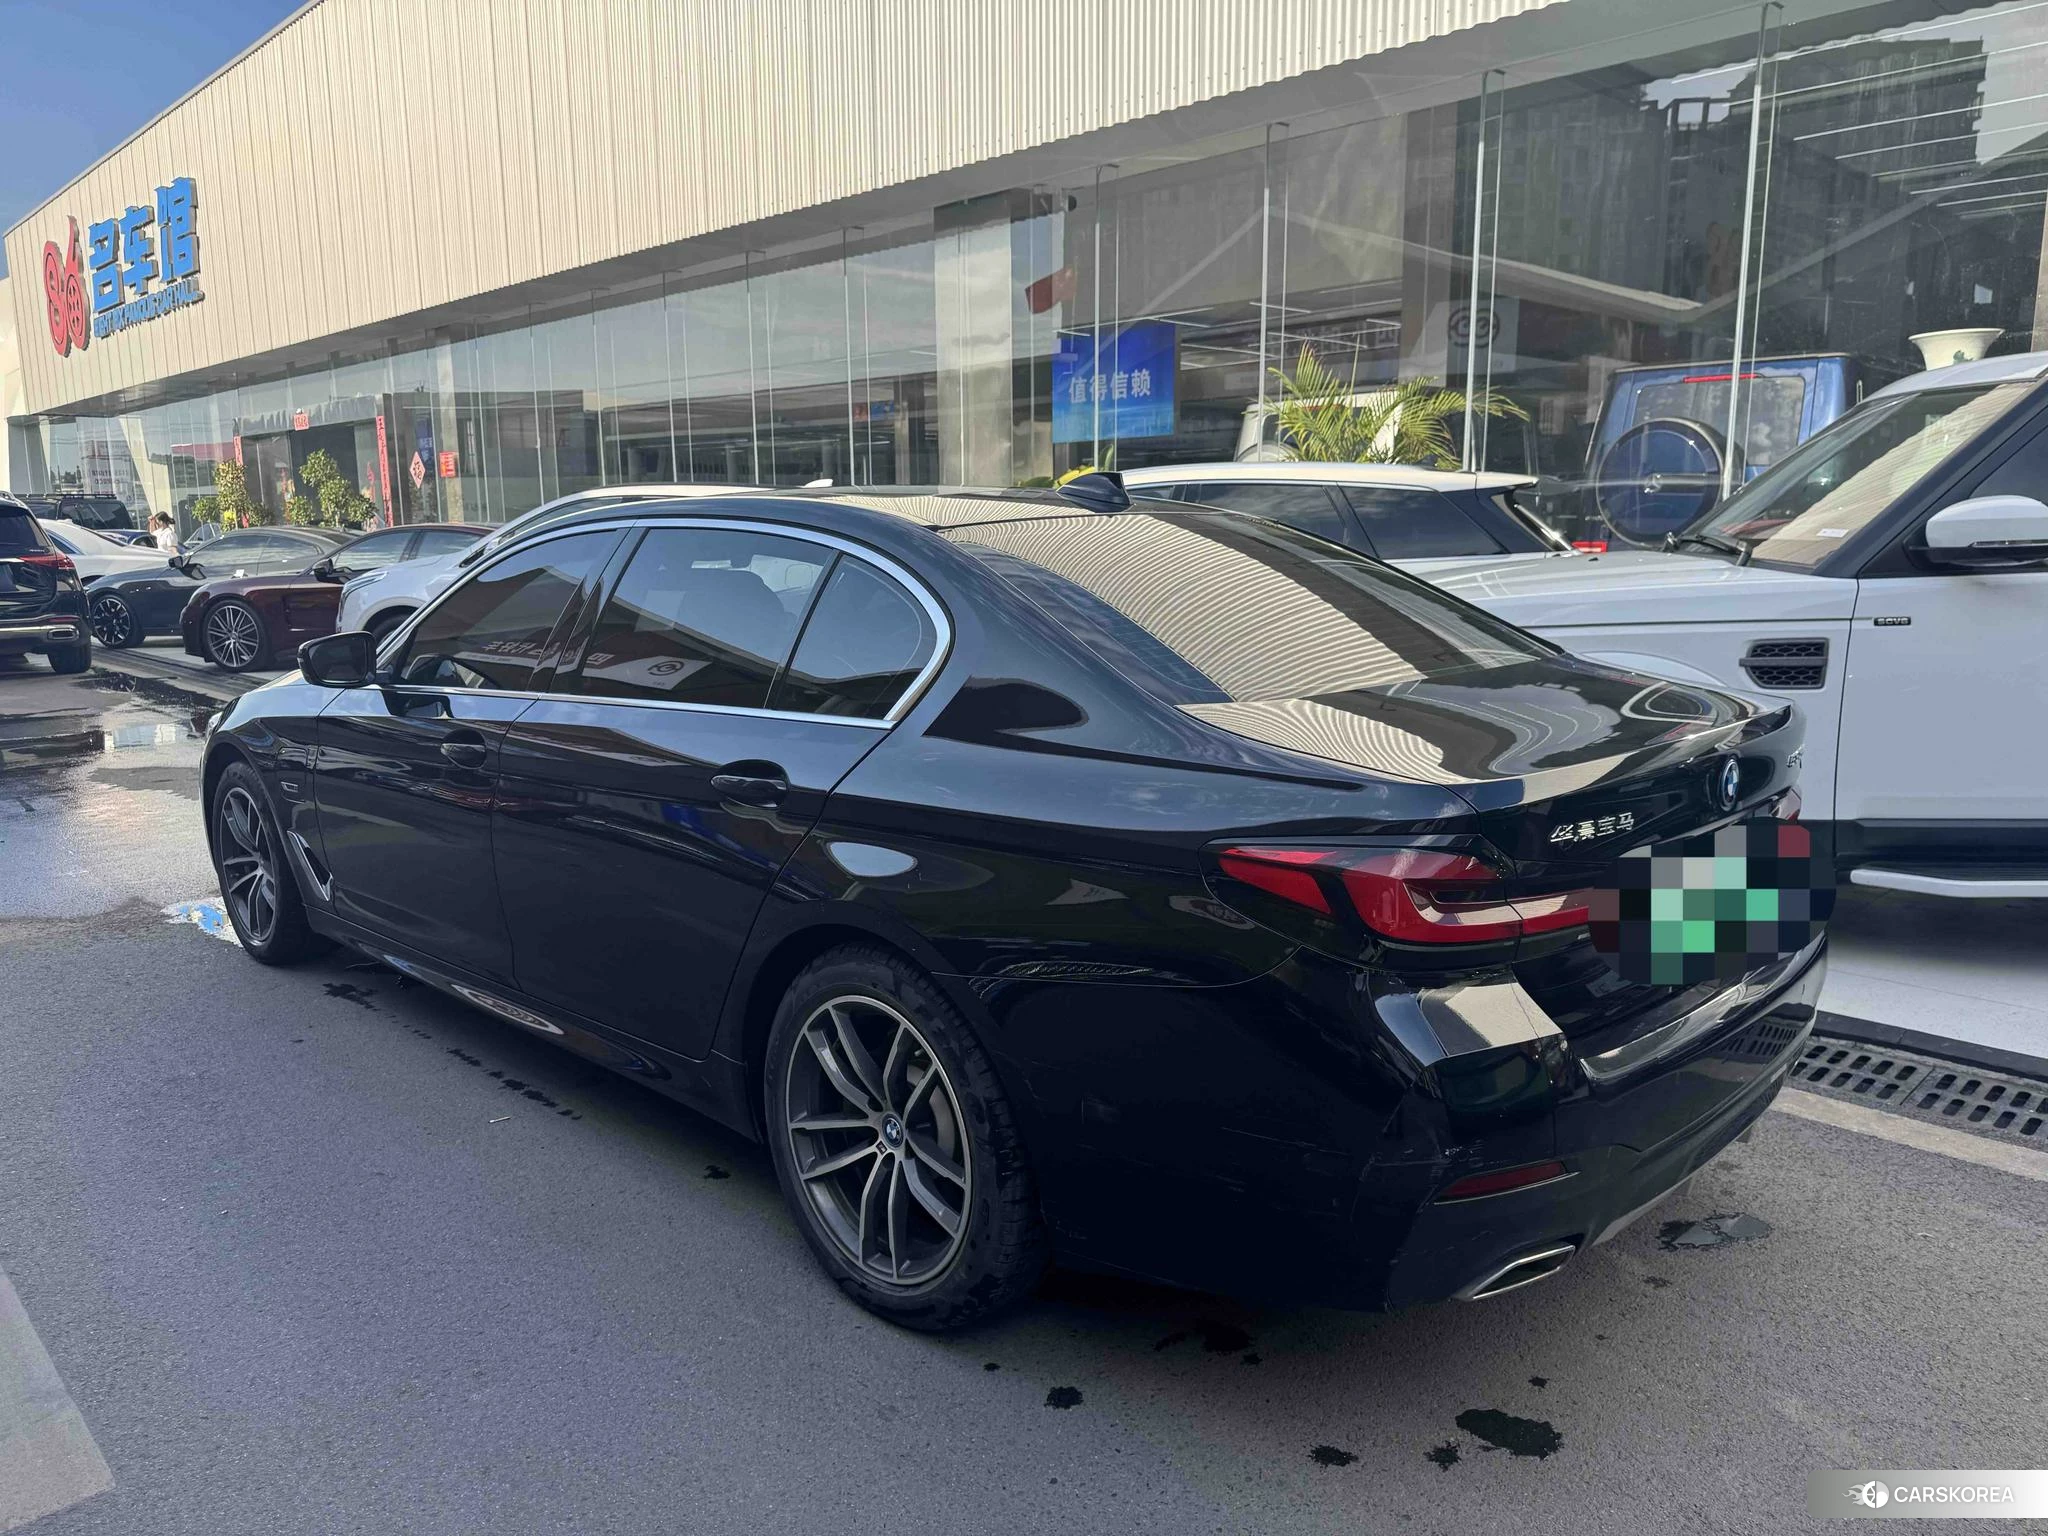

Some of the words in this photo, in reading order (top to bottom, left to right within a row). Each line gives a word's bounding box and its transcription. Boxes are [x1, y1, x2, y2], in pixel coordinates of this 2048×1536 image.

[89, 177, 199, 313] 名车馆
[1069, 368, 1151, 404] 值得信赖
